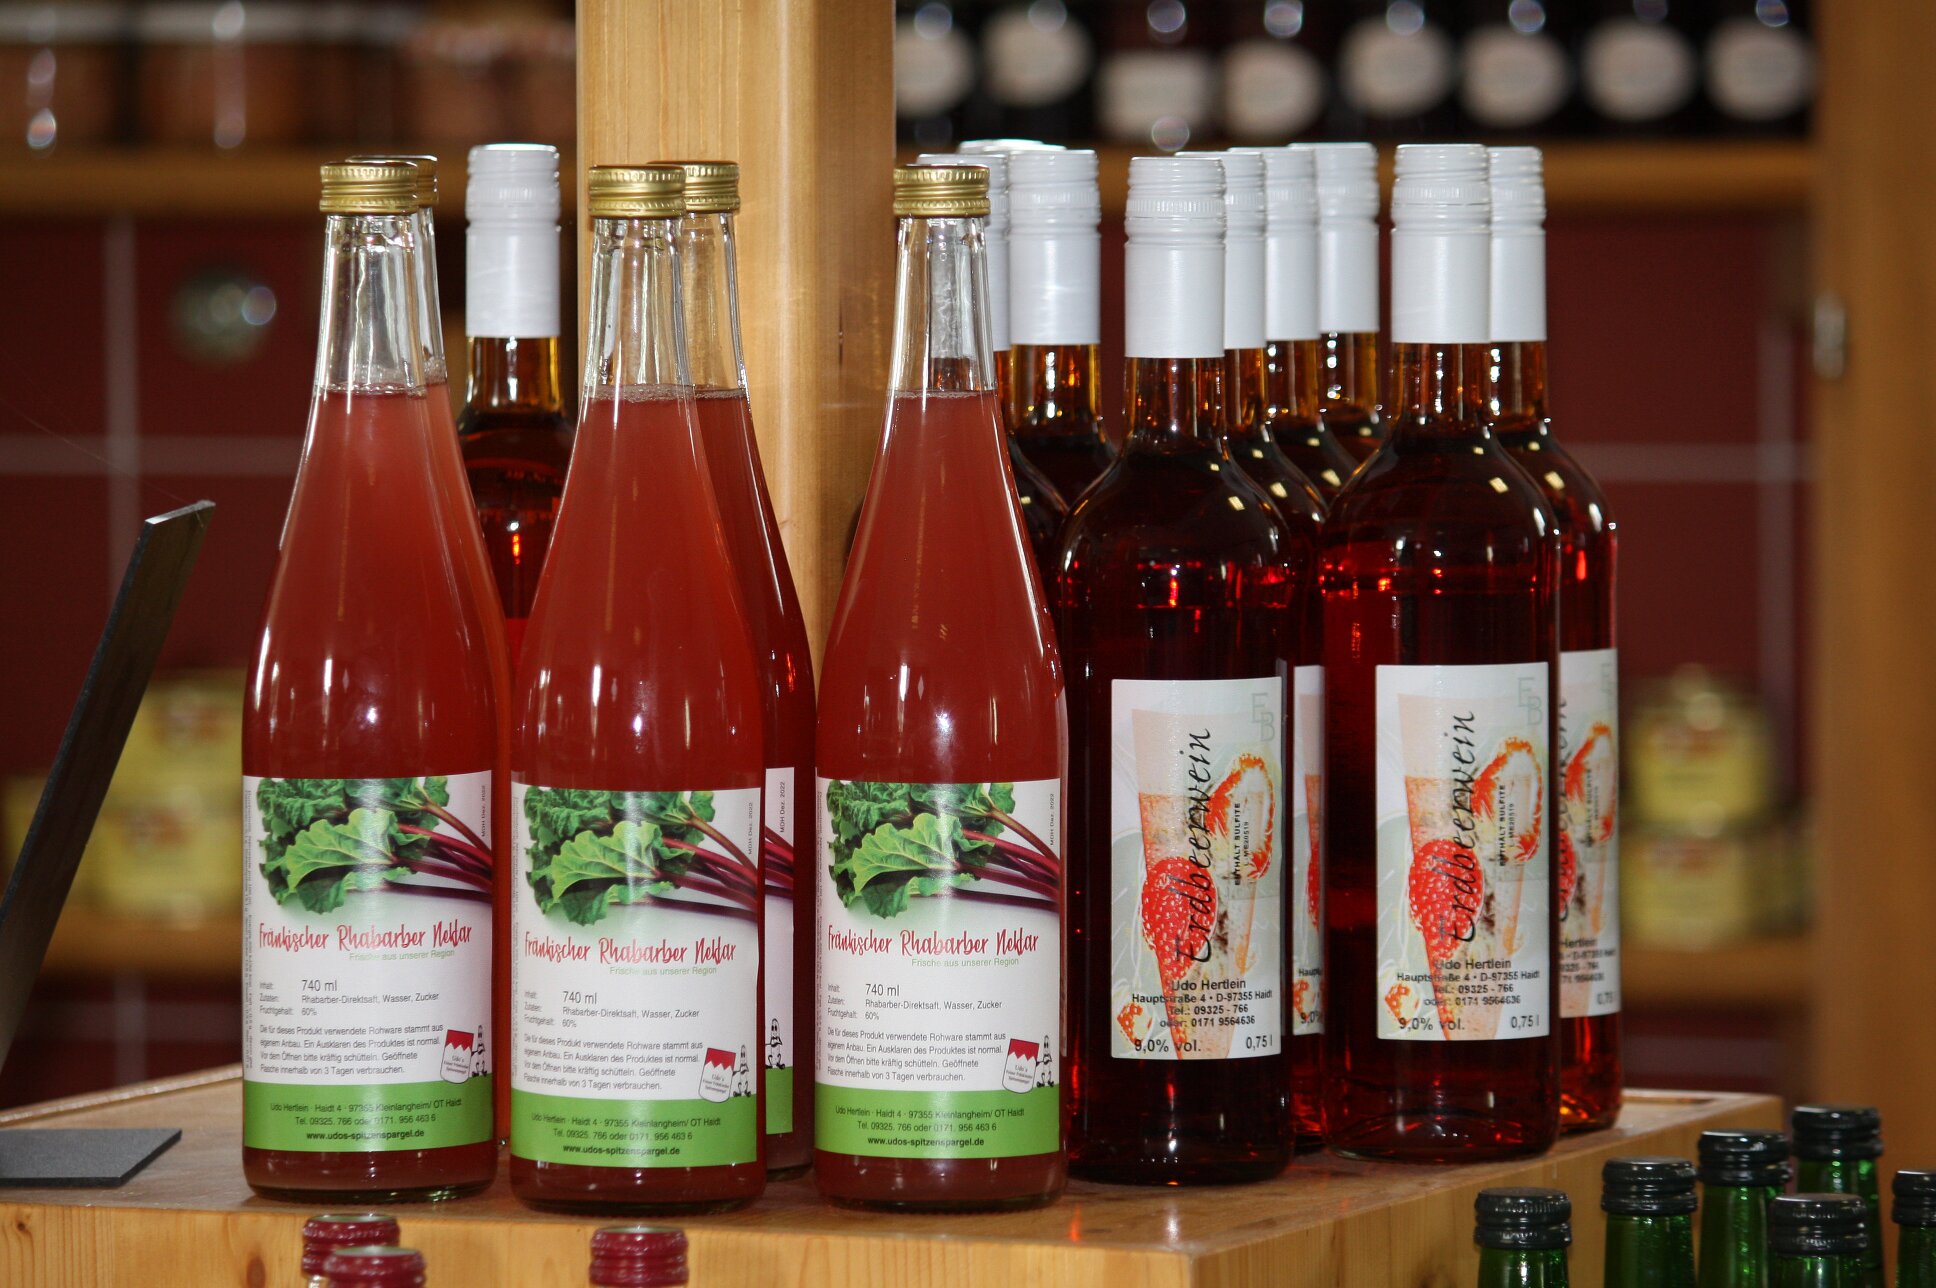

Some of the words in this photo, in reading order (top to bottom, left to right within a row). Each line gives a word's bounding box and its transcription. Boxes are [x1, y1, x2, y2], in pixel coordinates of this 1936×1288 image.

[1232, 803, 1241, 841] SULFITE
[1432, 711, 1477, 943] Erdbeerwein
[1168, 728, 1213, 963] Erdbeerwein
[260, 922, 330, 953] Fränkischer
[336, 924, 426, 952] Rhabarber
[433, 919, 472, 948] Nektar
[828, 924, 892, 956] Fränkischer
[900, 929, 989, 957] Rhabarber
[996, 927, 1039, 956] Nektar
[525, 931, 591, 964] Fränkischer
[598, 938, 688, 964] Rhabarber
[695, 936, 737, 965] Nektar
[431, 949, 455, 960] Region
[962, 959, 991, 967] unserer
[994, 957, 1019, 968] Region
[1435, 959, 1461, 970] Udo
[1465, 959, 1511, 970] Hertlein
[692, 967, 717, 976] Region
[1464, 973, 1470, 983] 4
[1480, 972, 1519, 982] D-97355
[1521, 970, 1540, 980] Haidt
[301, 980, 321, 992] 740
[324, 980, 337, 992] ml
[865, 984, 884, 996] 740
[887, 984, 901, 997] ml
[1172, 980, 1198, 991] Udo
[1201, 979, 1246, 991] Hertlein
[1458, 985, 1488, 994] 09325
[1498, 984, 1514, 993] 766
[415, 992, 440, 1002] Zucker
[562, 991, 581, 1004] 740
[585, 992, 597, 1004] ml
[1132, 994, 1197, 1005] Hauptstraße
[1200, 994, 1206, 1003] 4
[1216, 992, 1253, 1003] D-97355
[1254, 990, 1272, 999] Haidt
[1455, 997, 1479, 1006] 0171
[865, 999, 942, 1011] Rhabarber-Direktsaft,
[944, 1001, 975, 1011] Wasser,
[977, 1001, 1002, 1010] Zucker
[1194, 1006, 1224, 1015] 09325
[1233, 1004, 1249, 1013] 766
[641, 1010, 673, 1019] Wasser,
[675, 1009, 700, 1018] Zucker
[865, 1012, 880, 1020] 60%
[1191, 1018, 1215, 1028] 0171
[1219, 1016, 1256, 1027] 9564636
[1399, 1017, 1434, 1031] 9,0%
[1440, 1017, 1466, 1031] vol.
[1511, 1016, 1534, 1030] 0,75
[368, 1026, 401, 1035] Rohware
[404, 1025, 430, 1034] stammt
[431, 1024, 444, 1032] aus
[842, 1029, 859, 1038] dieses
[860, 1031, 884, 1040] Produkt
[886, 1033, 928, 1041] verwendete
[930, 1033, 963, 1041] Rohware
[966, 1033, 992, 1041] stammt
[626, 1041, 661, 1050] Rohware
[662, 1042, 689, 1050] stammt
[866, 1044, 877, 1053] Ein
[914, 1046, 927, 1054] des
[929, 1046, 966, 1055] Produktes
[968, 1046, 976, 1054] ist
[1135, 1039, 1169, 1053] 9,0%
[1176, 1040, 1201, 1052] vol.
[1246, 1035, 1268, 1050] 0,75
[846, 1054, 865, 1065] Öffnen
[866, 1058, 880, 1067] bitte
[881, 1058, 903, 1069] kräftig
[942, 1060, 979, 1068] Geöffnete
[845, 1070, 871, 1079] innerhalb
[872, 1072, 884, 1080] von
[885, 1072, 890, 1080] 3
[892, 1072, 915, 1083] Tagen
[916, 1072, 966, 1081] verbrauchen.
[836, 1105, 847, 1115] Udo
[847, 1107, 871, 1117] Hertlein
[876, 1109, 895, 1118] Haidt
[897, 1110, 902, 1118] 4
[908, 1111, 933, 1119] 97355
[994, 1109, 1006, 1118] OT
[898, 1123, 911, 1131] 766
[914, 1123, 932, 1132] oder
[958, 1123, 973, 1132] 956
[976, 1123, 990, 1132] 463
[992, 1123, 997, 1131] 6
[868, 1137, 985, 1148] www.udos-spitzenspargel.de
